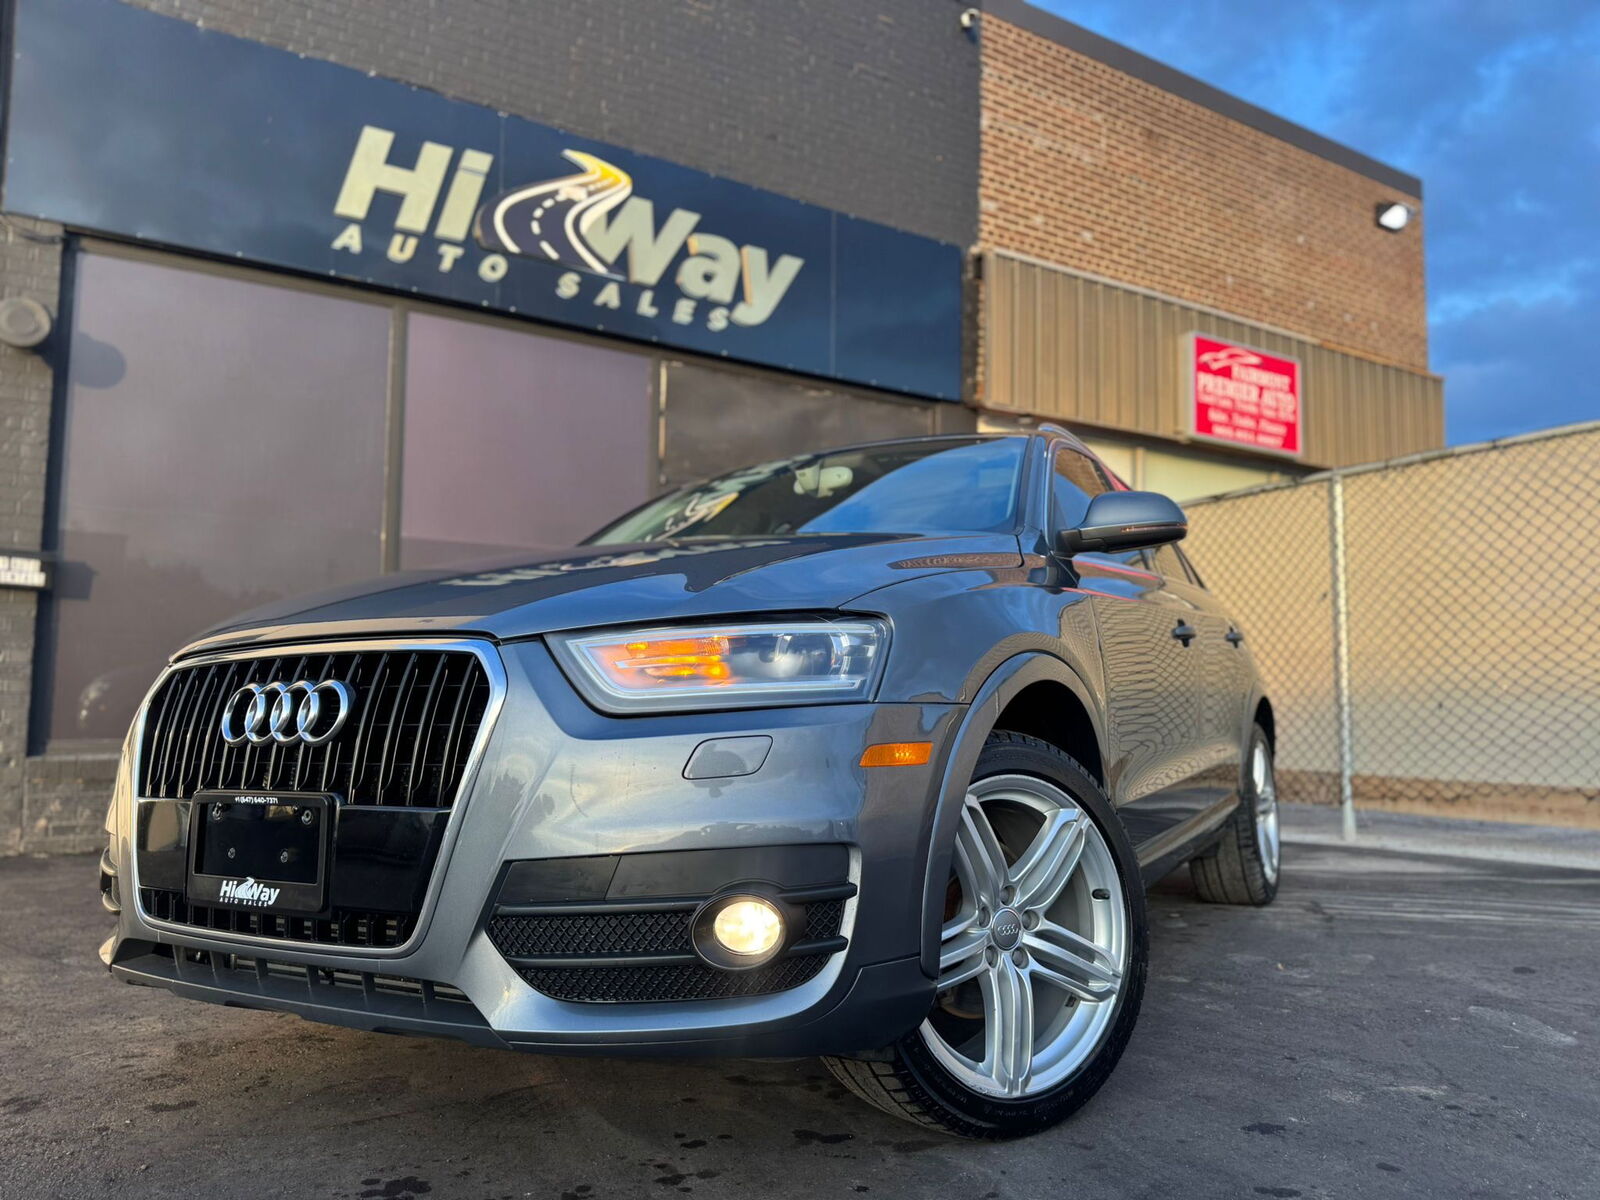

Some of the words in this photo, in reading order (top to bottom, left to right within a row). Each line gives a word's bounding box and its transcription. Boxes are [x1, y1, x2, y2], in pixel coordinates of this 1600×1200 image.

[331, 222, 509, 283] AUTO
[556, 271, 731, 332] SALES
[219, 897, 239, 905] AUTO
[243, 899, 268, 907] SALES
